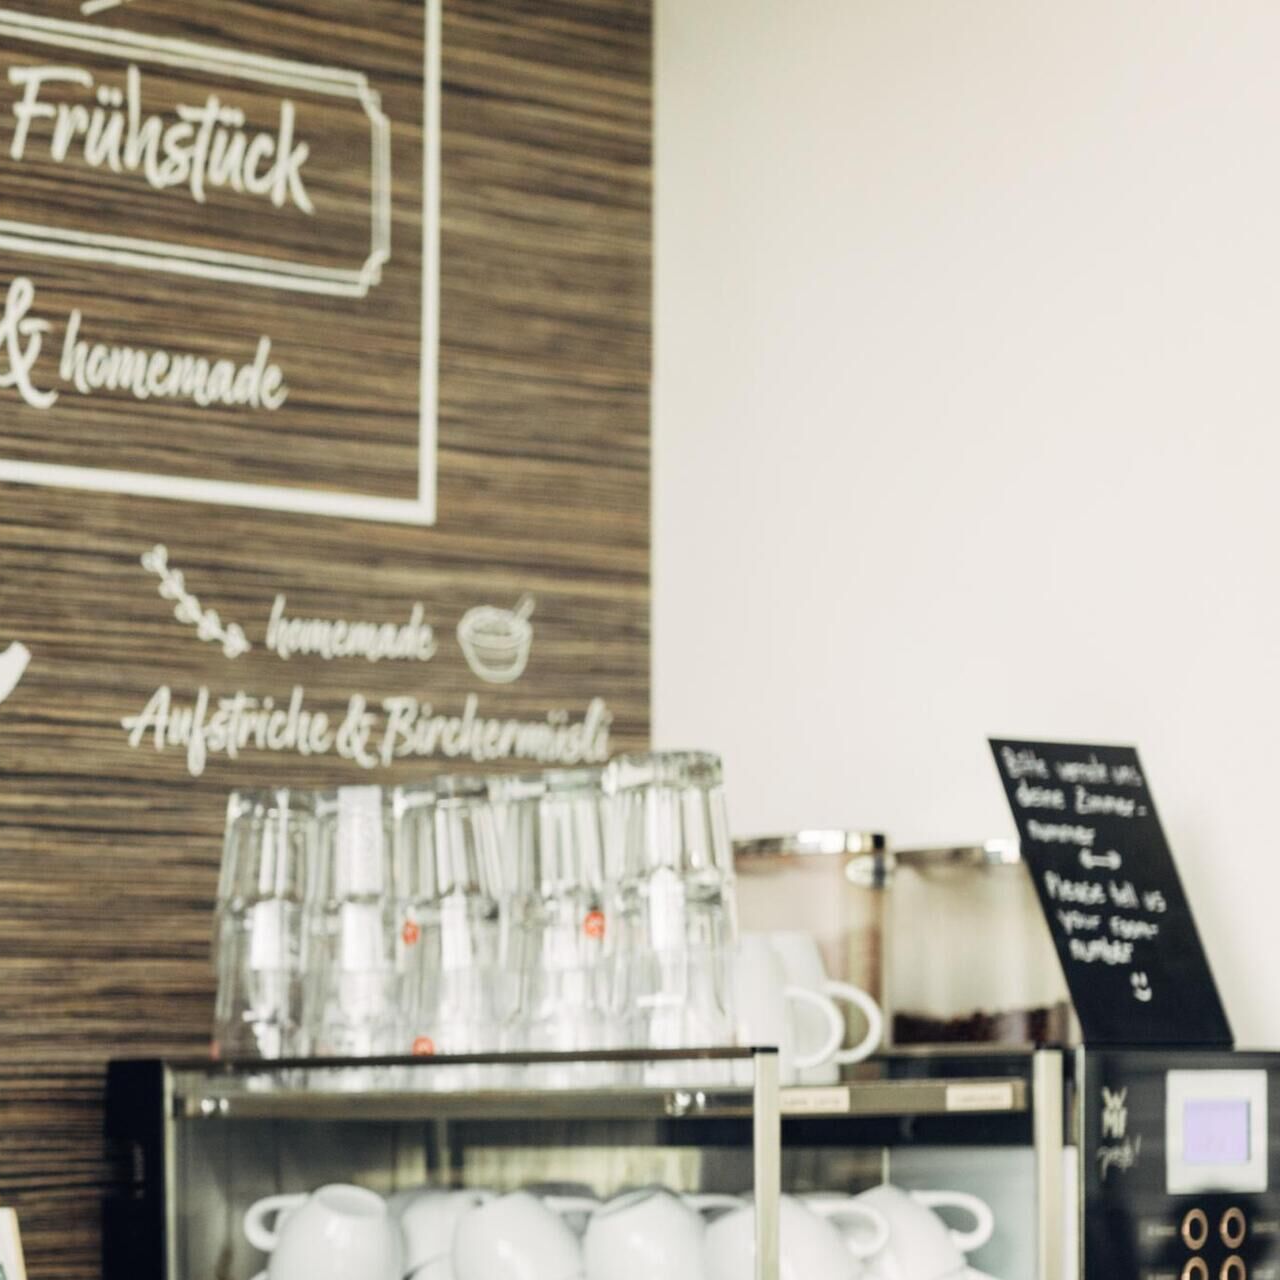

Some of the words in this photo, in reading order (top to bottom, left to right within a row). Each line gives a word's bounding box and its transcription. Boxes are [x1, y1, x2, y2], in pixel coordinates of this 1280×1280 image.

[8, 63, 315, 214] Frühstück
[59, 308, 289, 411] homemade
[265, 592, 437, 662] homemade
[120, 684, 335, 777] Aufstriche
[336, 692, 379, 769] &
[378, 692, 613, 768] Birchermüsli
